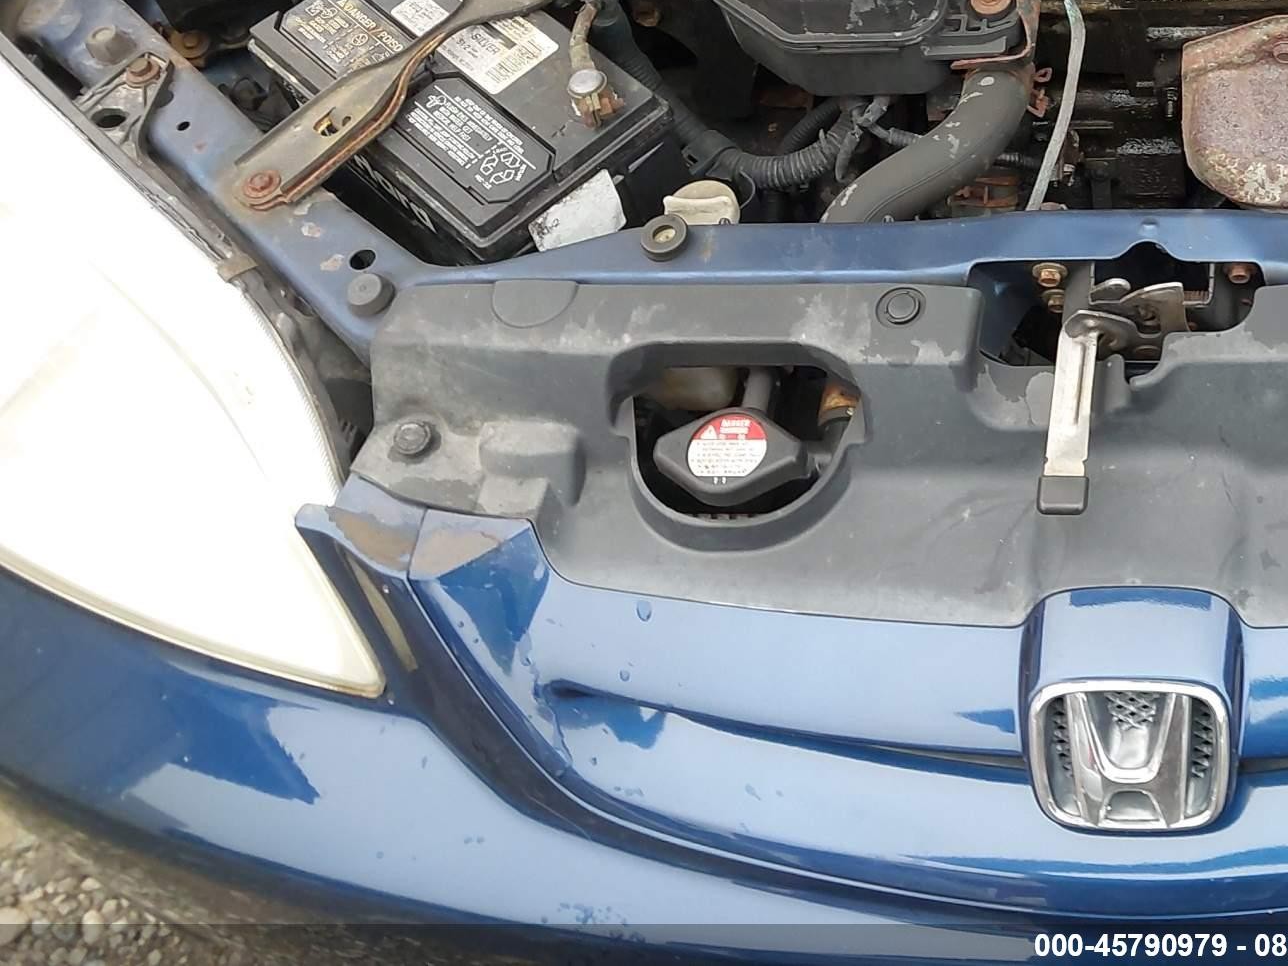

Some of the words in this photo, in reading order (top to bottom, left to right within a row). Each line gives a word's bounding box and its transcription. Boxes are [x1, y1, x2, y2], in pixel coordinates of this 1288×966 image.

[346, 5, 376, 29] DANGER
[378, 31, 403, 51] POISO
[471, 33, 500, 55] SILVER
